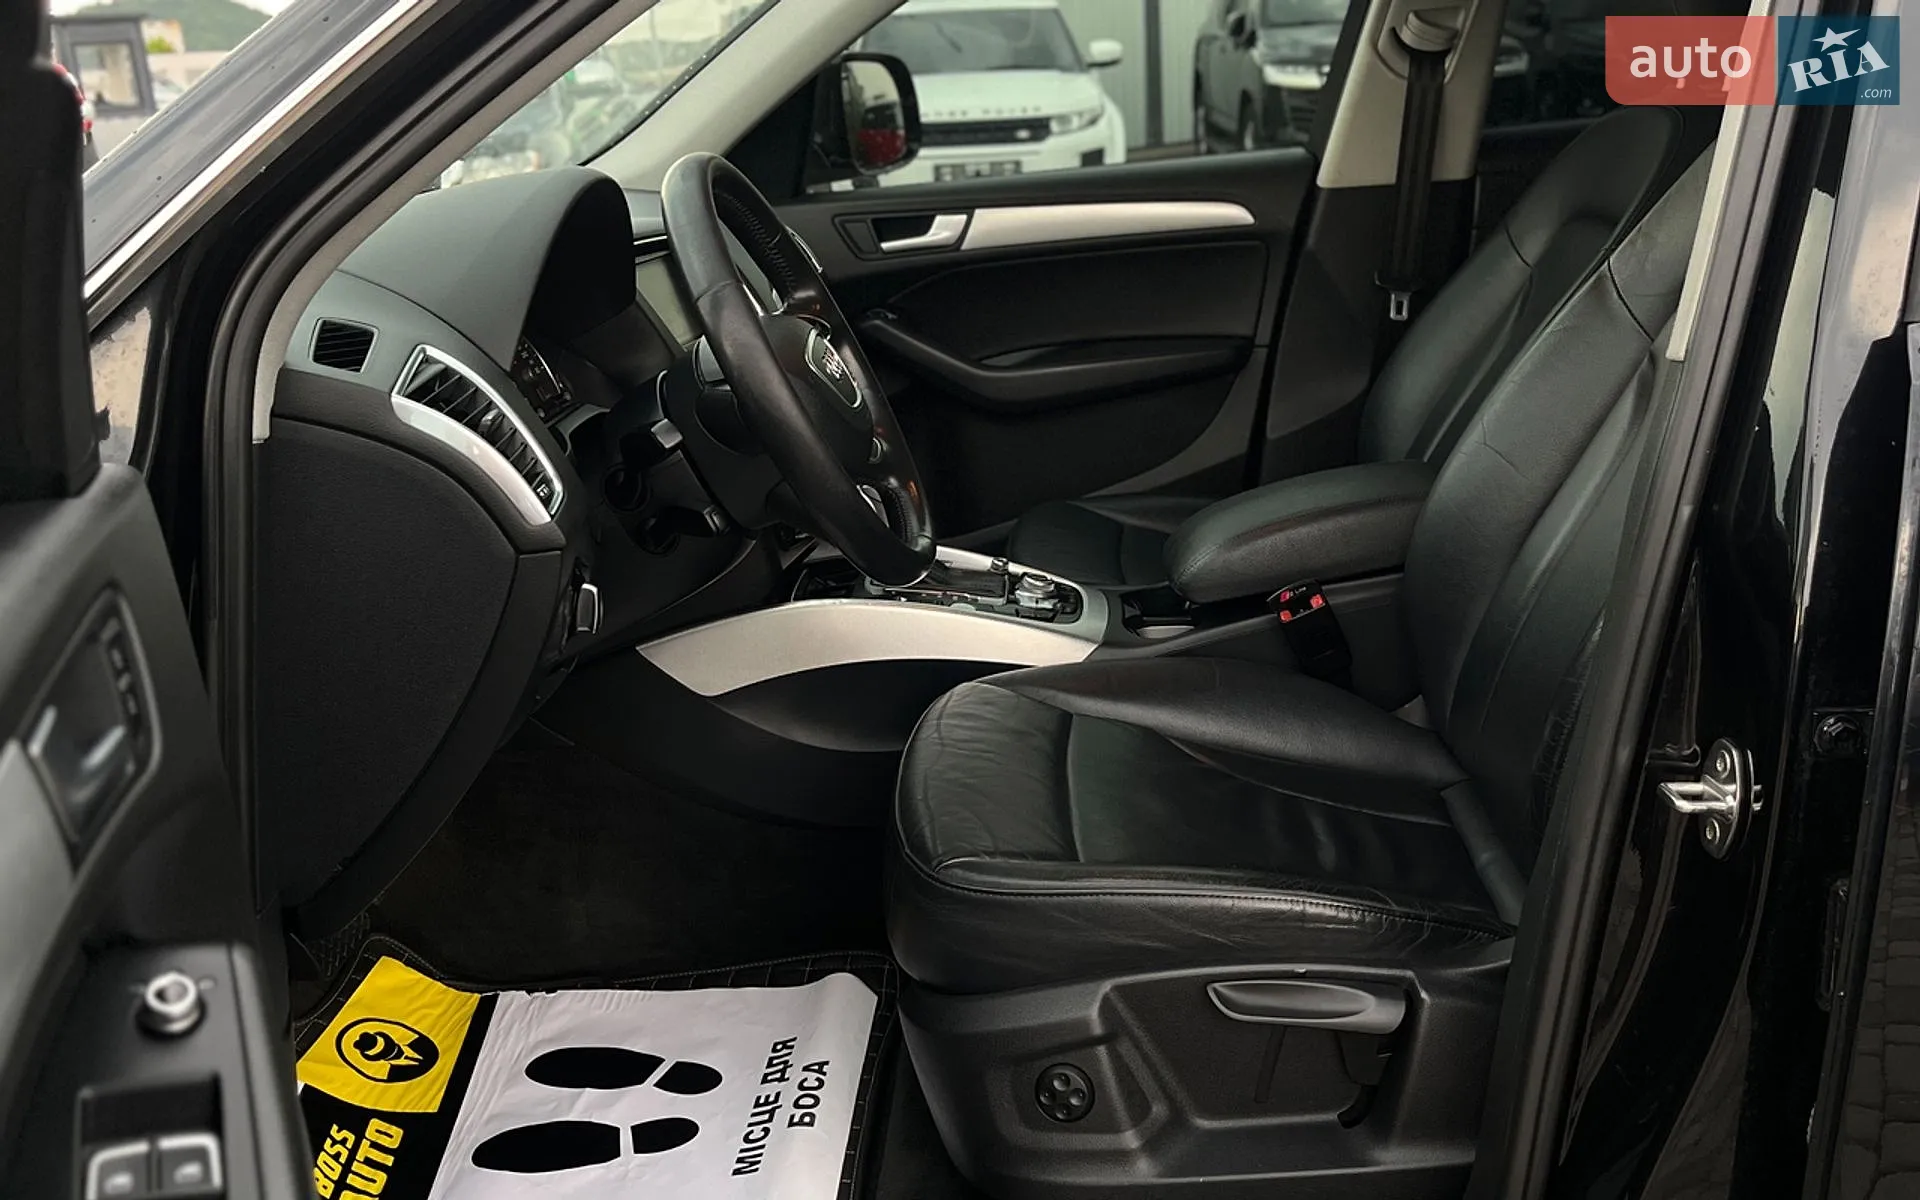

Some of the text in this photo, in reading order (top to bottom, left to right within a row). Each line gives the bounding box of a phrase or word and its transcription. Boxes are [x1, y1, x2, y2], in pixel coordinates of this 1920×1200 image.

[731, 1036, 798, 1176] МІСЦЕ ДЛЯ
[786, 1060, 830, 1128] БОСА
[313, 1123, 356, 1199] BOSS
